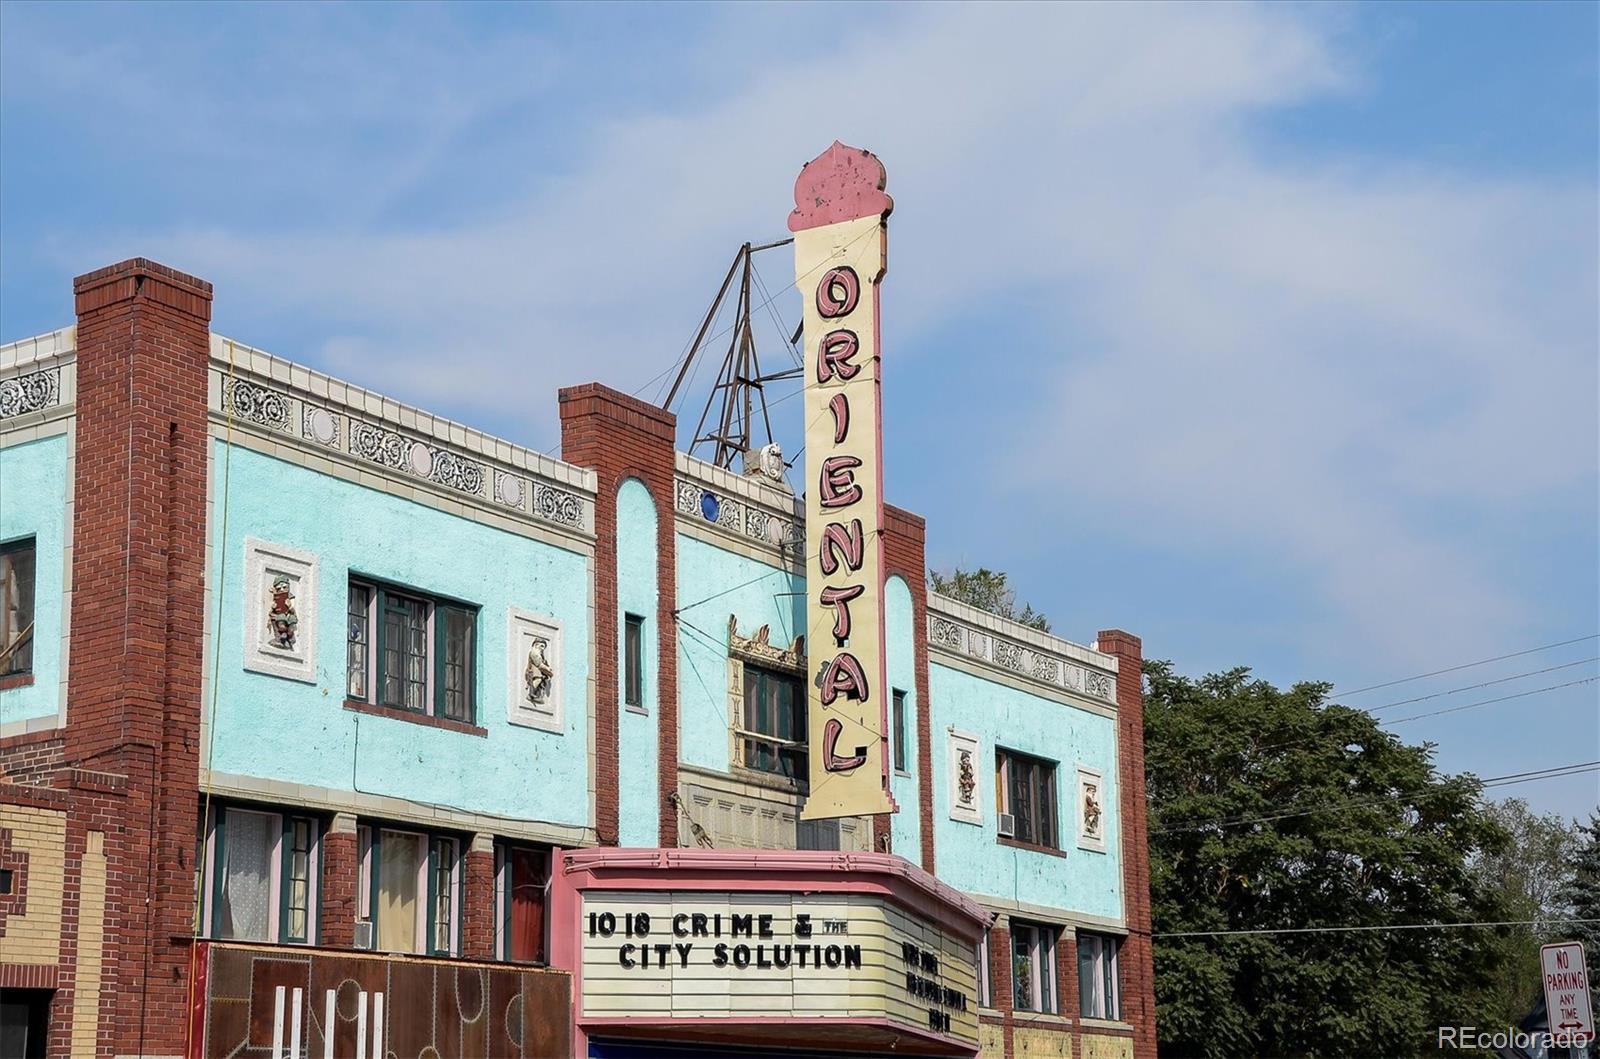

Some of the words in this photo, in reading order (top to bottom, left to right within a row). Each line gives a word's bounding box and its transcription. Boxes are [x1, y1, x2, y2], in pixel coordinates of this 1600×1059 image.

[817, 265, 870, 772] ORIENTAL
[672, 913, 773, 940] CRIME
[795, 914, 812, 939] &
[824, 921, 848, 934] THE
[619, 943, 693, 969] CITY
[712, 943, 862, 970] SOLUTION
[1556, 951, 1569, 969] NO
[1547, 971, 1584, 991] PARKING
[1559, 994, 1575, 1006] ANY
[1560, 1008, 1578, 1020] TIME
